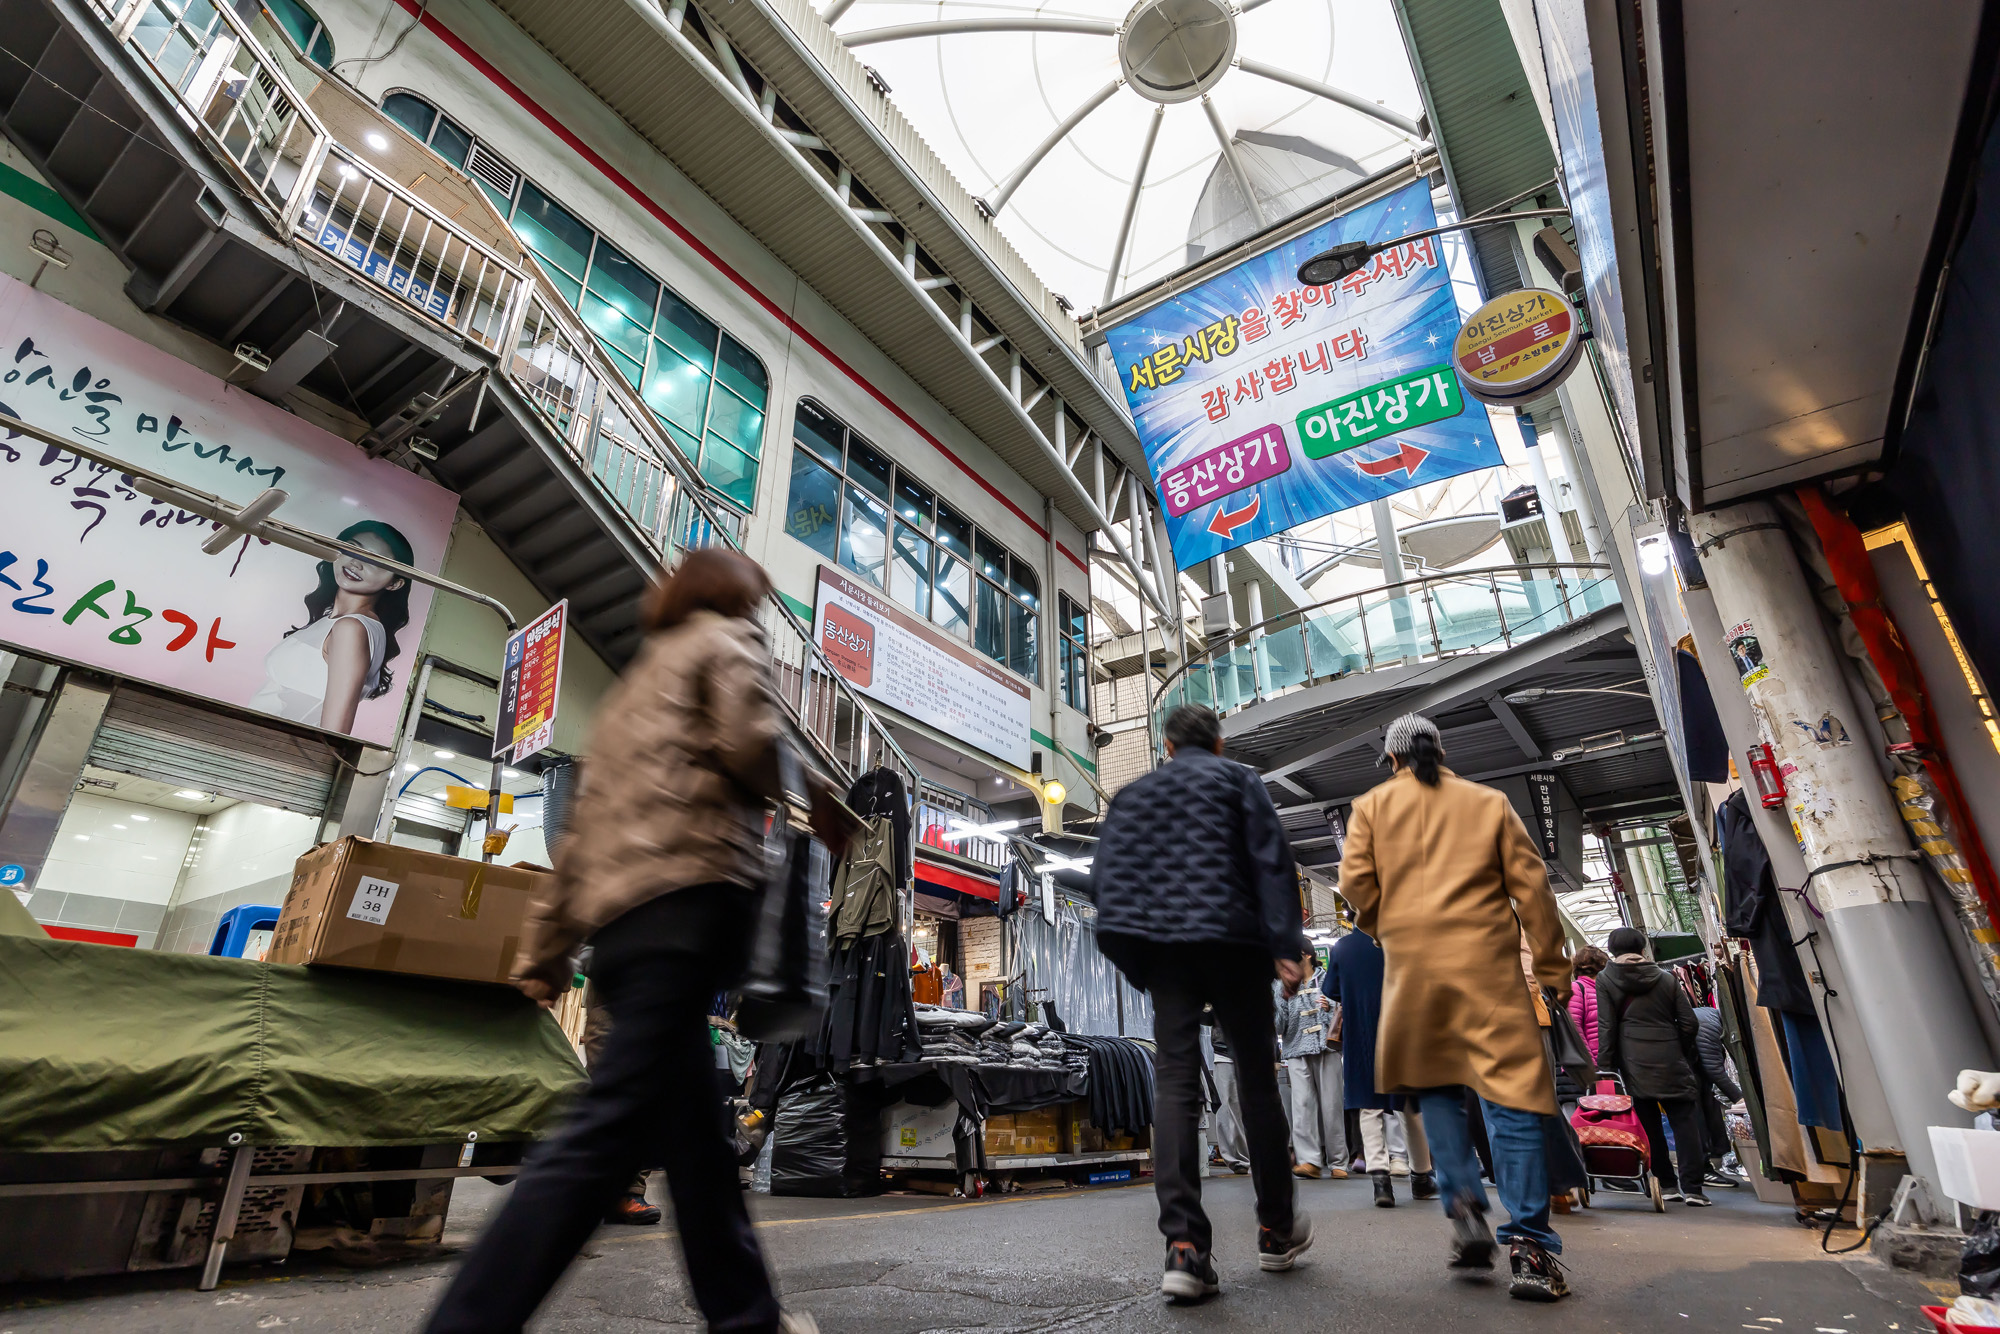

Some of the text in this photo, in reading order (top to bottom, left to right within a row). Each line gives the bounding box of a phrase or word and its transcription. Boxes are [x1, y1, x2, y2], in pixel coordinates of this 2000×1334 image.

[1130, 238, 1439, 394] 서문시장을 찾아 주셔서
[1467, 294, 1546, 338] 아진상가
[1468, 308, 1553, 350] Daegu Seomun Market
[1478, 322, 1554, 365] 남 로
[1500, 340, 1562, 372] 119 소방통로
[1201, 327, 1368, 423] 감사합니다
[1304, 372, 1450, 443] 아진상가
[136, 413, 286, 488] 만나서
[1165, 432, 1278, 508] 동산상가
[840, 580, 889, 615] 서문시장 둘러보기
[526, 609, 561, 648] 안동분식
[824, 618, 871, 658] 동산상가
[507, 667, 519, 713] 먹거리
[1531, 774, 1555, 782] 서문시장
[1540, 785, 1555, 852] 만남의 장소 1
[362, 901, 381, 913] 38
[366, 884, 390, 898] PH
